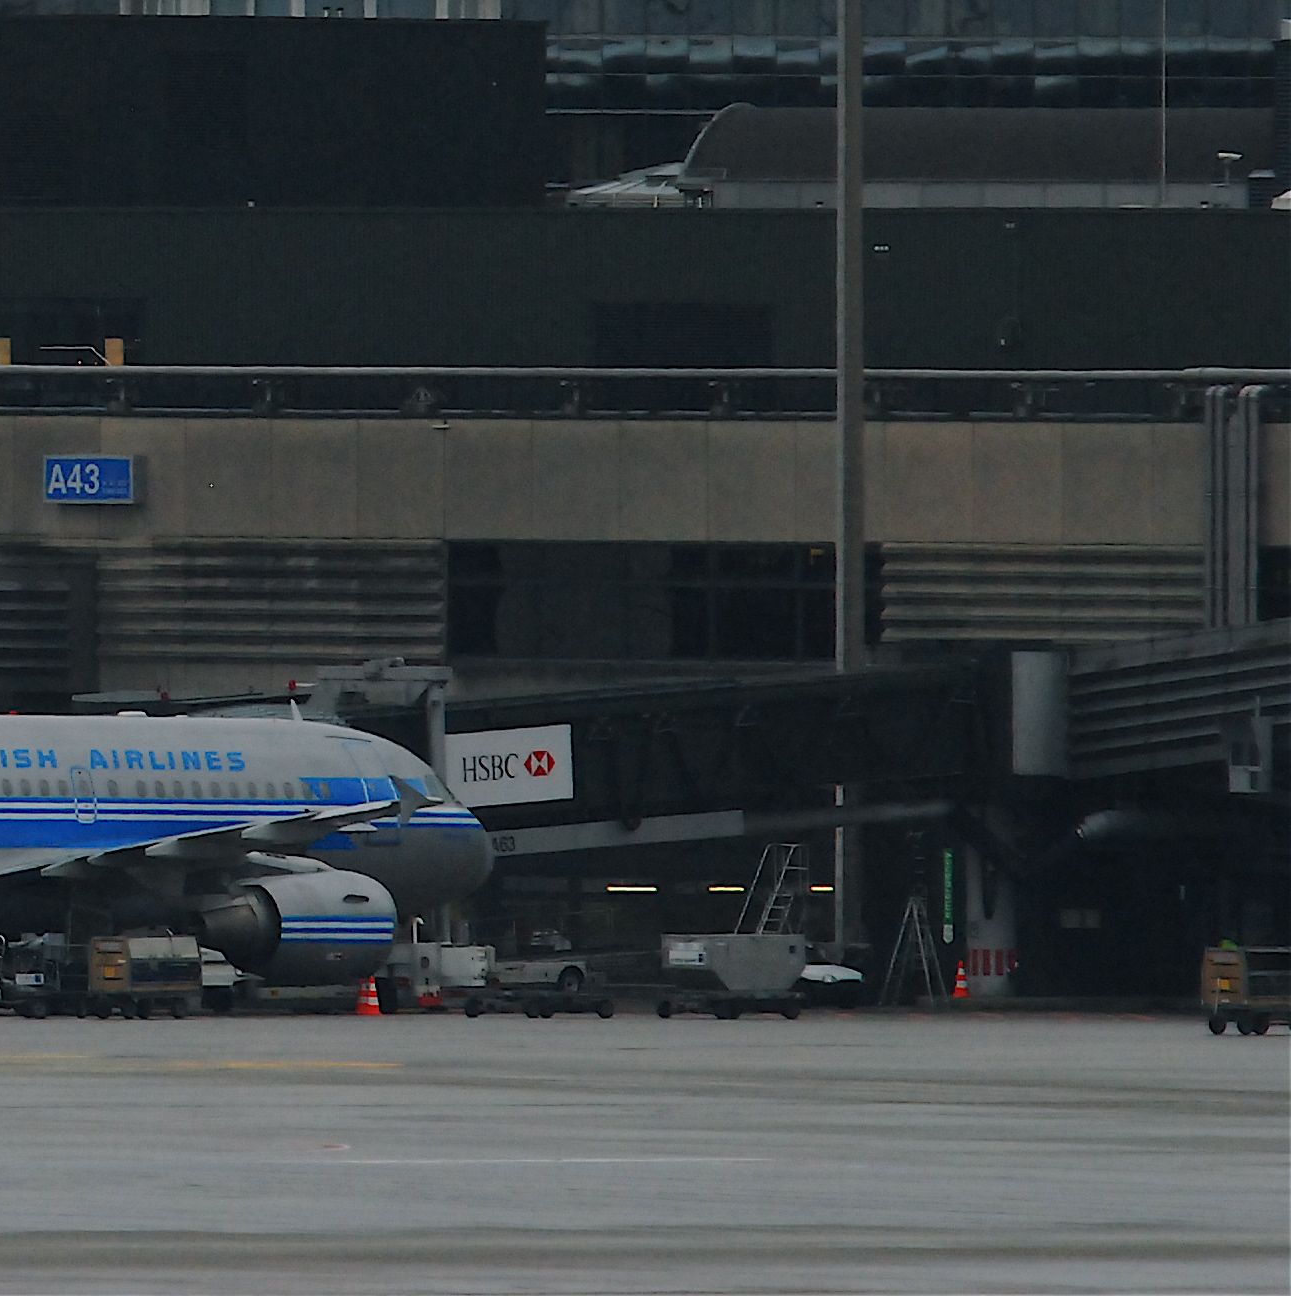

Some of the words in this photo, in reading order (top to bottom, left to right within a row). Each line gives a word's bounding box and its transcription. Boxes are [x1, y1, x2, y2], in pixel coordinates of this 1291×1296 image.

[47, 463, 101, 494] A43
[89, 749, 246, 773] AIRLINES
[462, 753, 519, 783] HSBC
